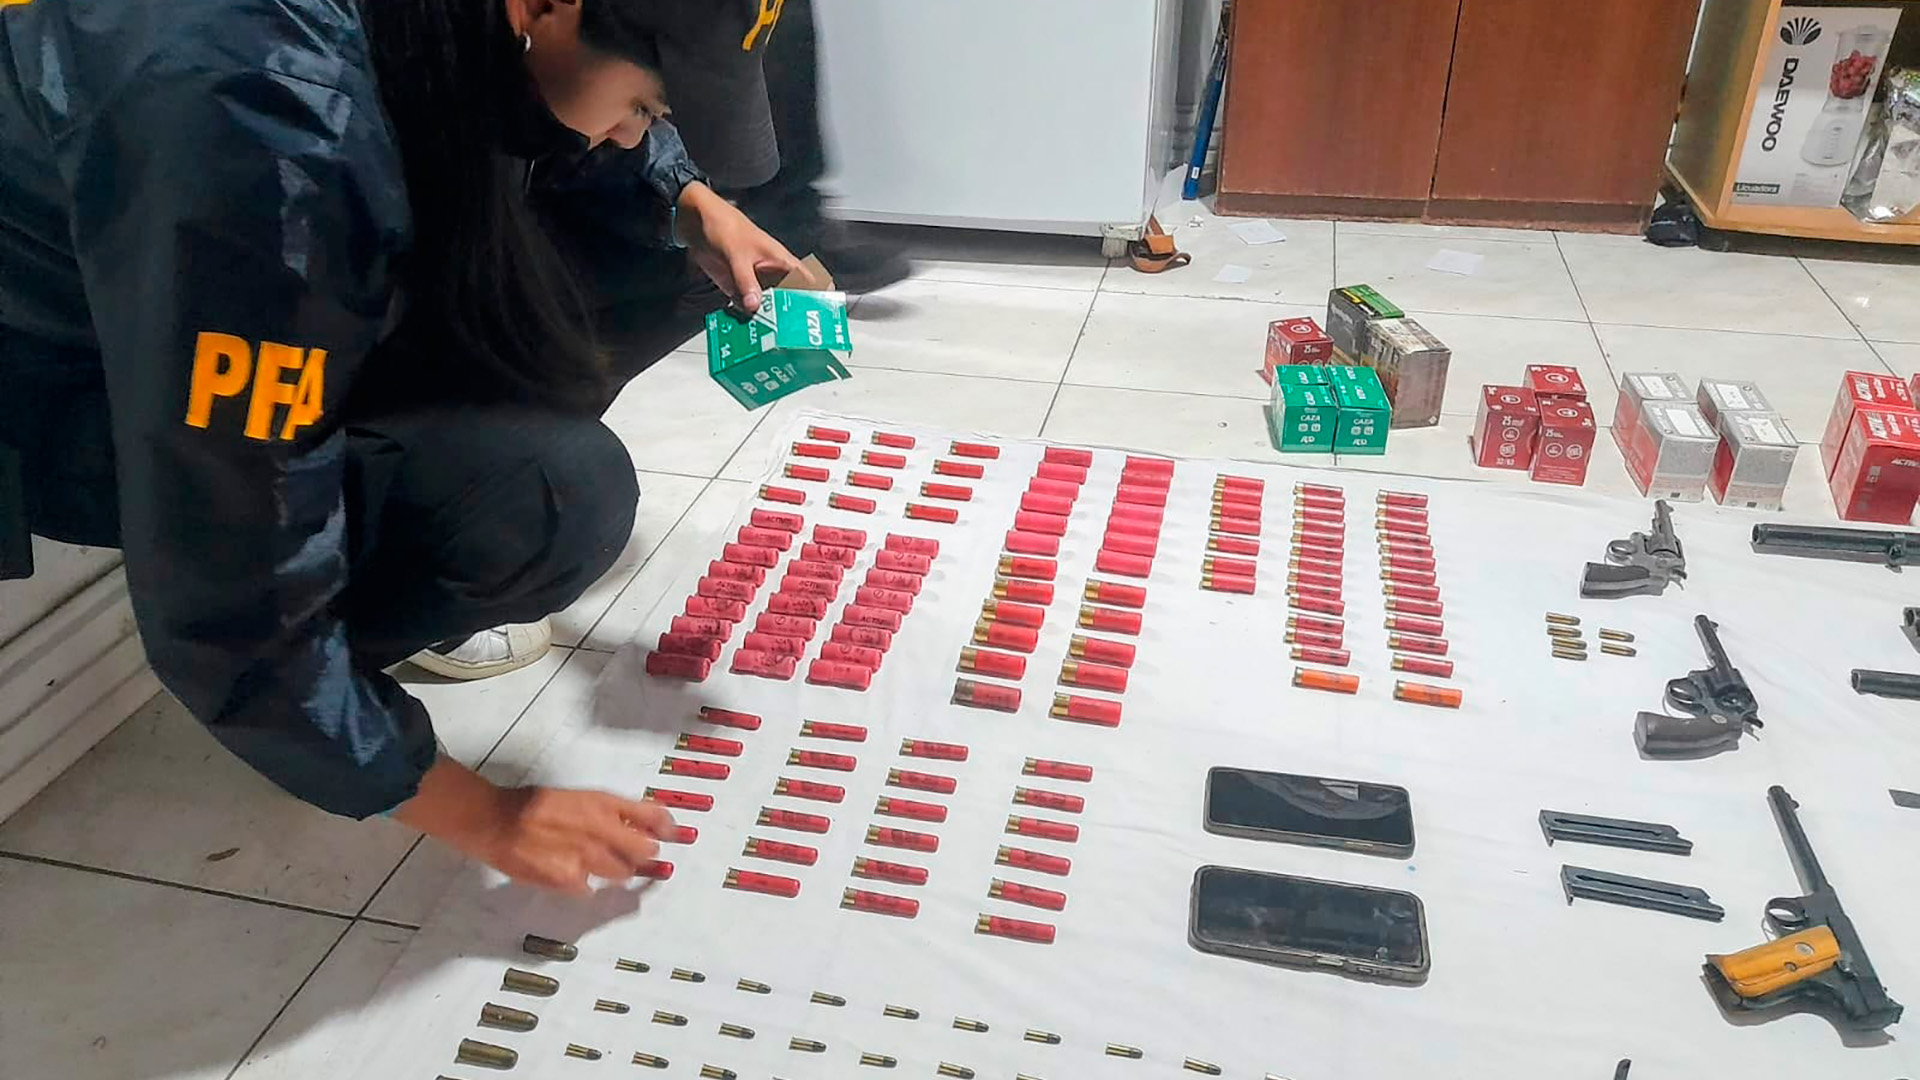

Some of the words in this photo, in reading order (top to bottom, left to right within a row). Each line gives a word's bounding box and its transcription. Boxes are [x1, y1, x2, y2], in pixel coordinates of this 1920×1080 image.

[1761, 57, 1799, 152] DAEWOO
[1736, 183, 1778, 193] Licuadora
[748, 320, 758, 345] CAZA
[805, 309, 823, 346] CAZA
[184, 331, 328, 440] PFA
[1300, 414, 1321, 422] CAZA
